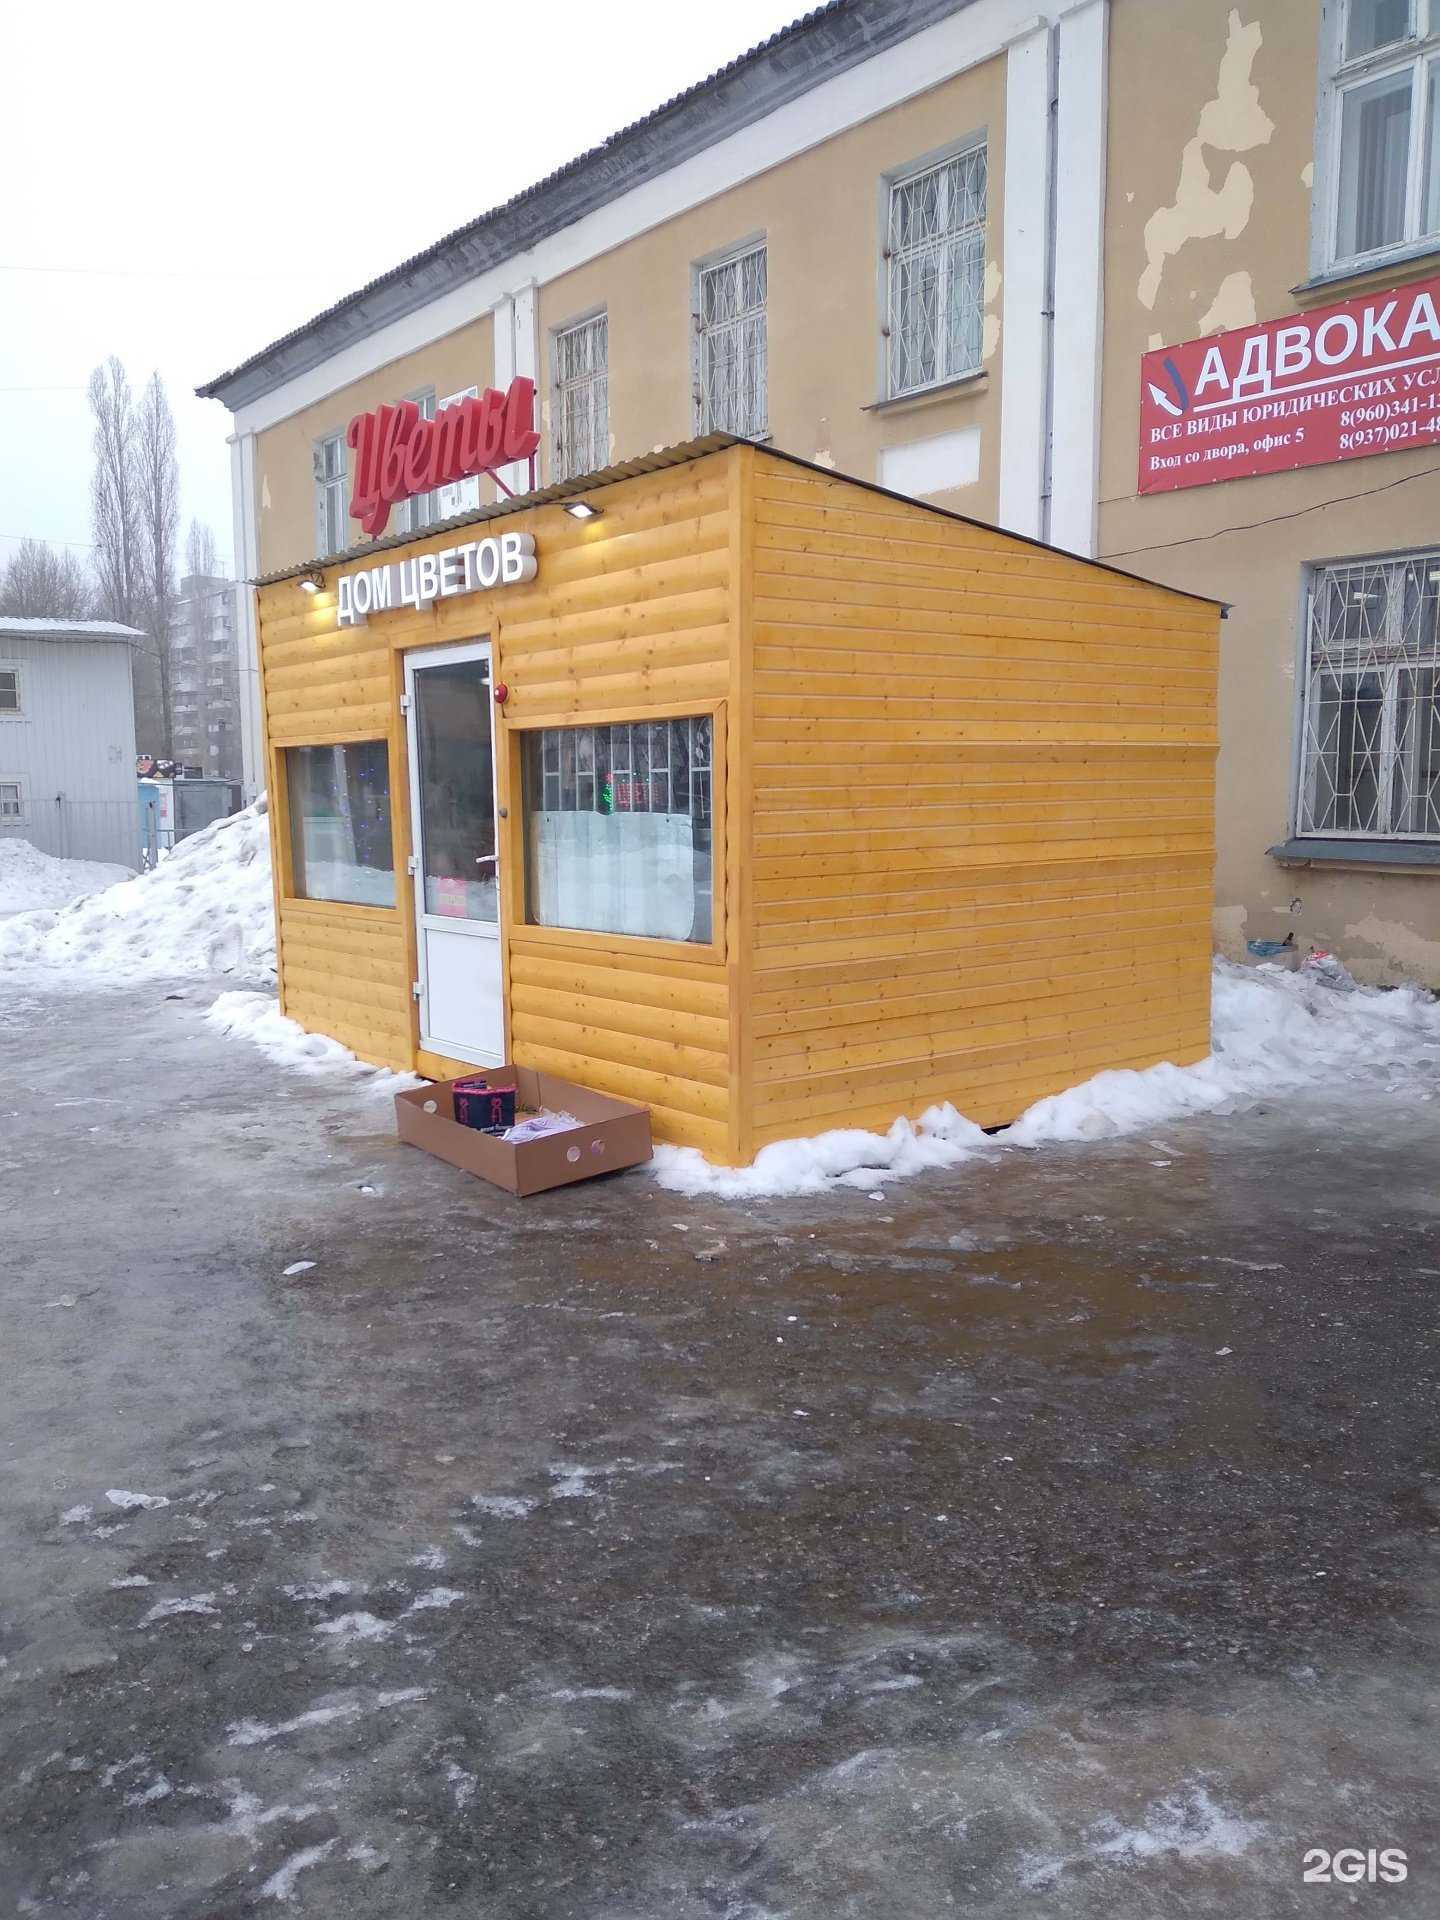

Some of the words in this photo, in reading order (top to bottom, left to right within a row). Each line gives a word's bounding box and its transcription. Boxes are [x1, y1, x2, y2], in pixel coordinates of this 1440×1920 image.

[1194, 292, 1440, 401] АДВОКА
[347, 376, 541, 536] Цветы
[1150, 423, 1182, 443] ВСЕ
[1187, 411, 1237, 435] ВИДЫ
[1243, 376, 1397, 424] ЮРИДИЧЕСКИХ
[1150, 455, 1181, 471] Вход
[1185, 452, 1200, 464] со
[1203, 441, 1250, 462] двора,
[1253, 431, 1291, 454] офис
[1295, 427, 1305, 443] 5
[337, 565, 392, 627] ДОМ
[400, 532, 530, 611] ЦВЕТОВ
